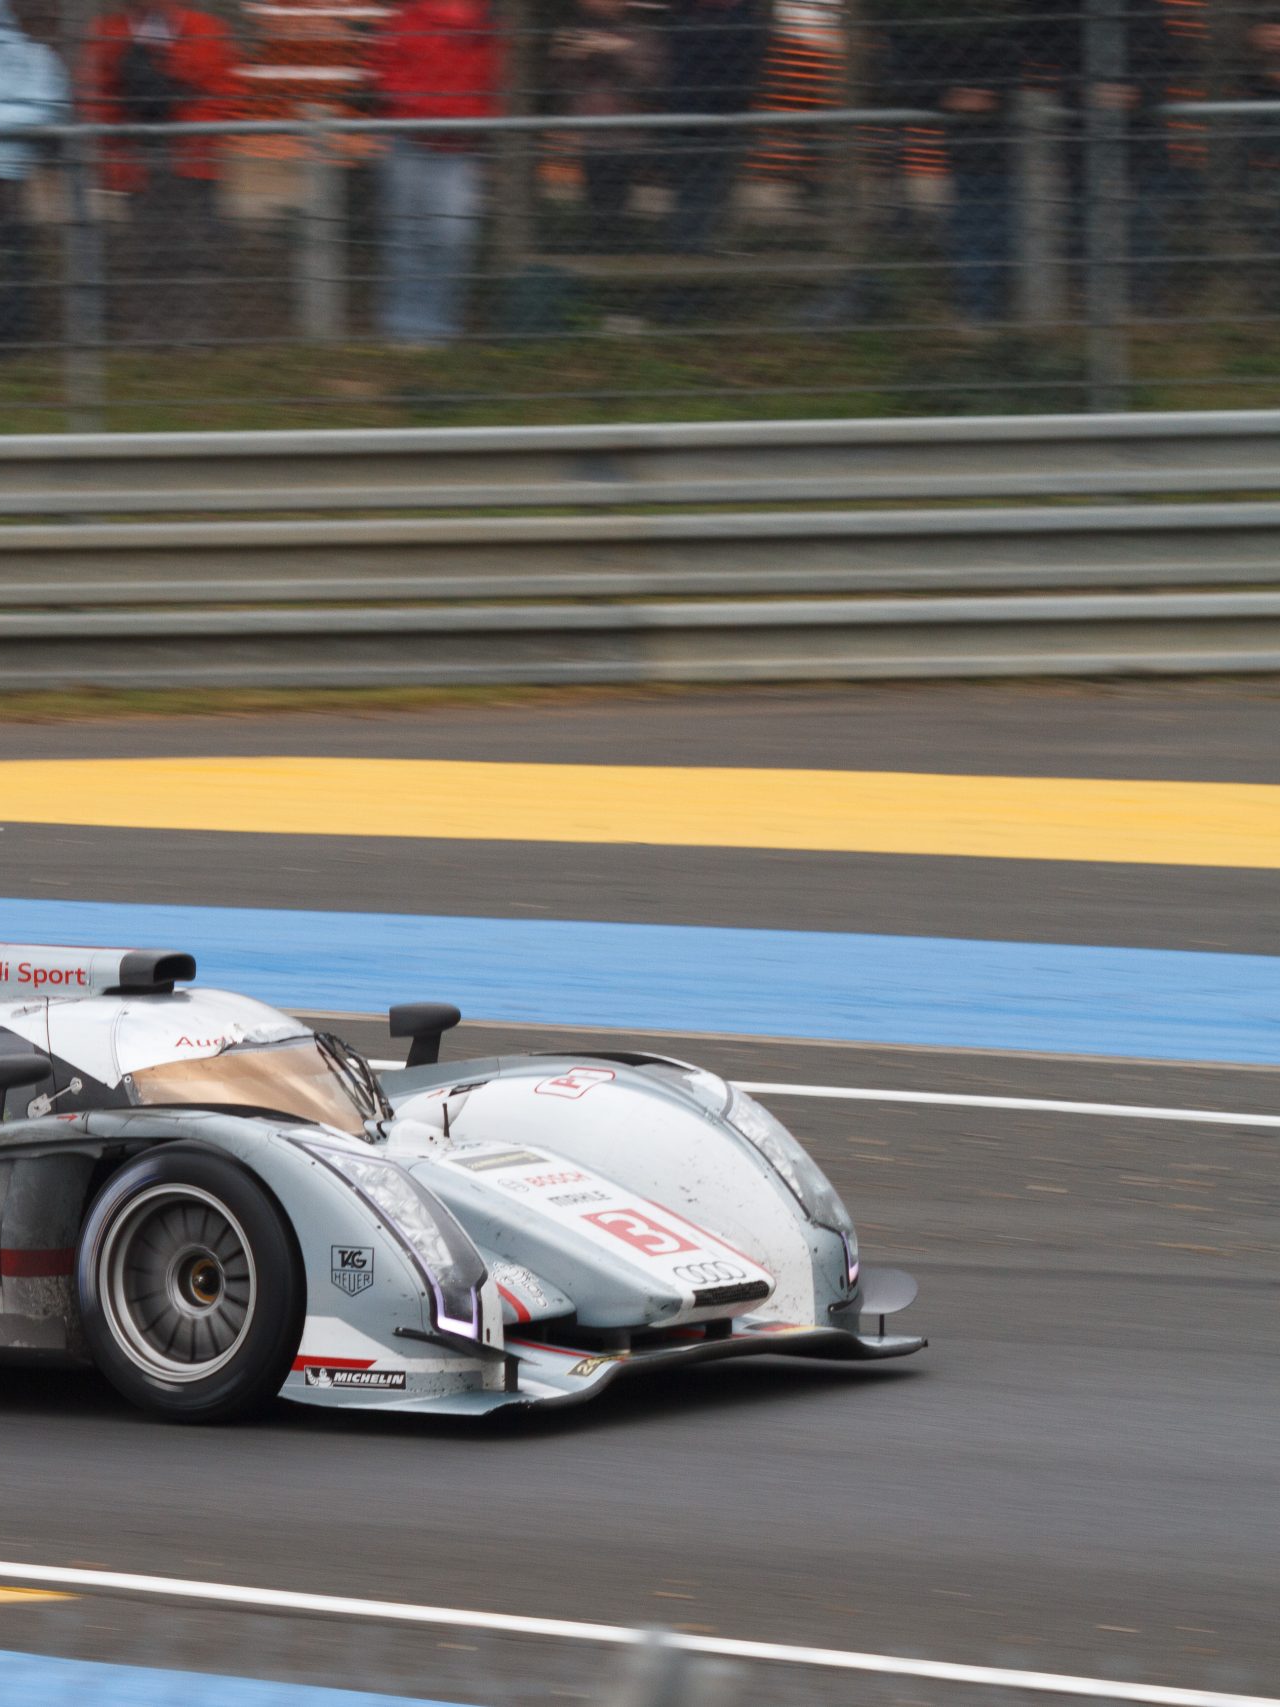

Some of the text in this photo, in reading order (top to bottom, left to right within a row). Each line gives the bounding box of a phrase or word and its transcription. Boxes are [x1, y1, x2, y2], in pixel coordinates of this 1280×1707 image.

[17, 962, 86, 988] Sport
[598, 1212, 681, 1252] 3
[338, 1249, 367, 1269] TAG
[334, 1273, 371, 1293] HEUER
[333, 1372, 405, 1385] MICHELIN
